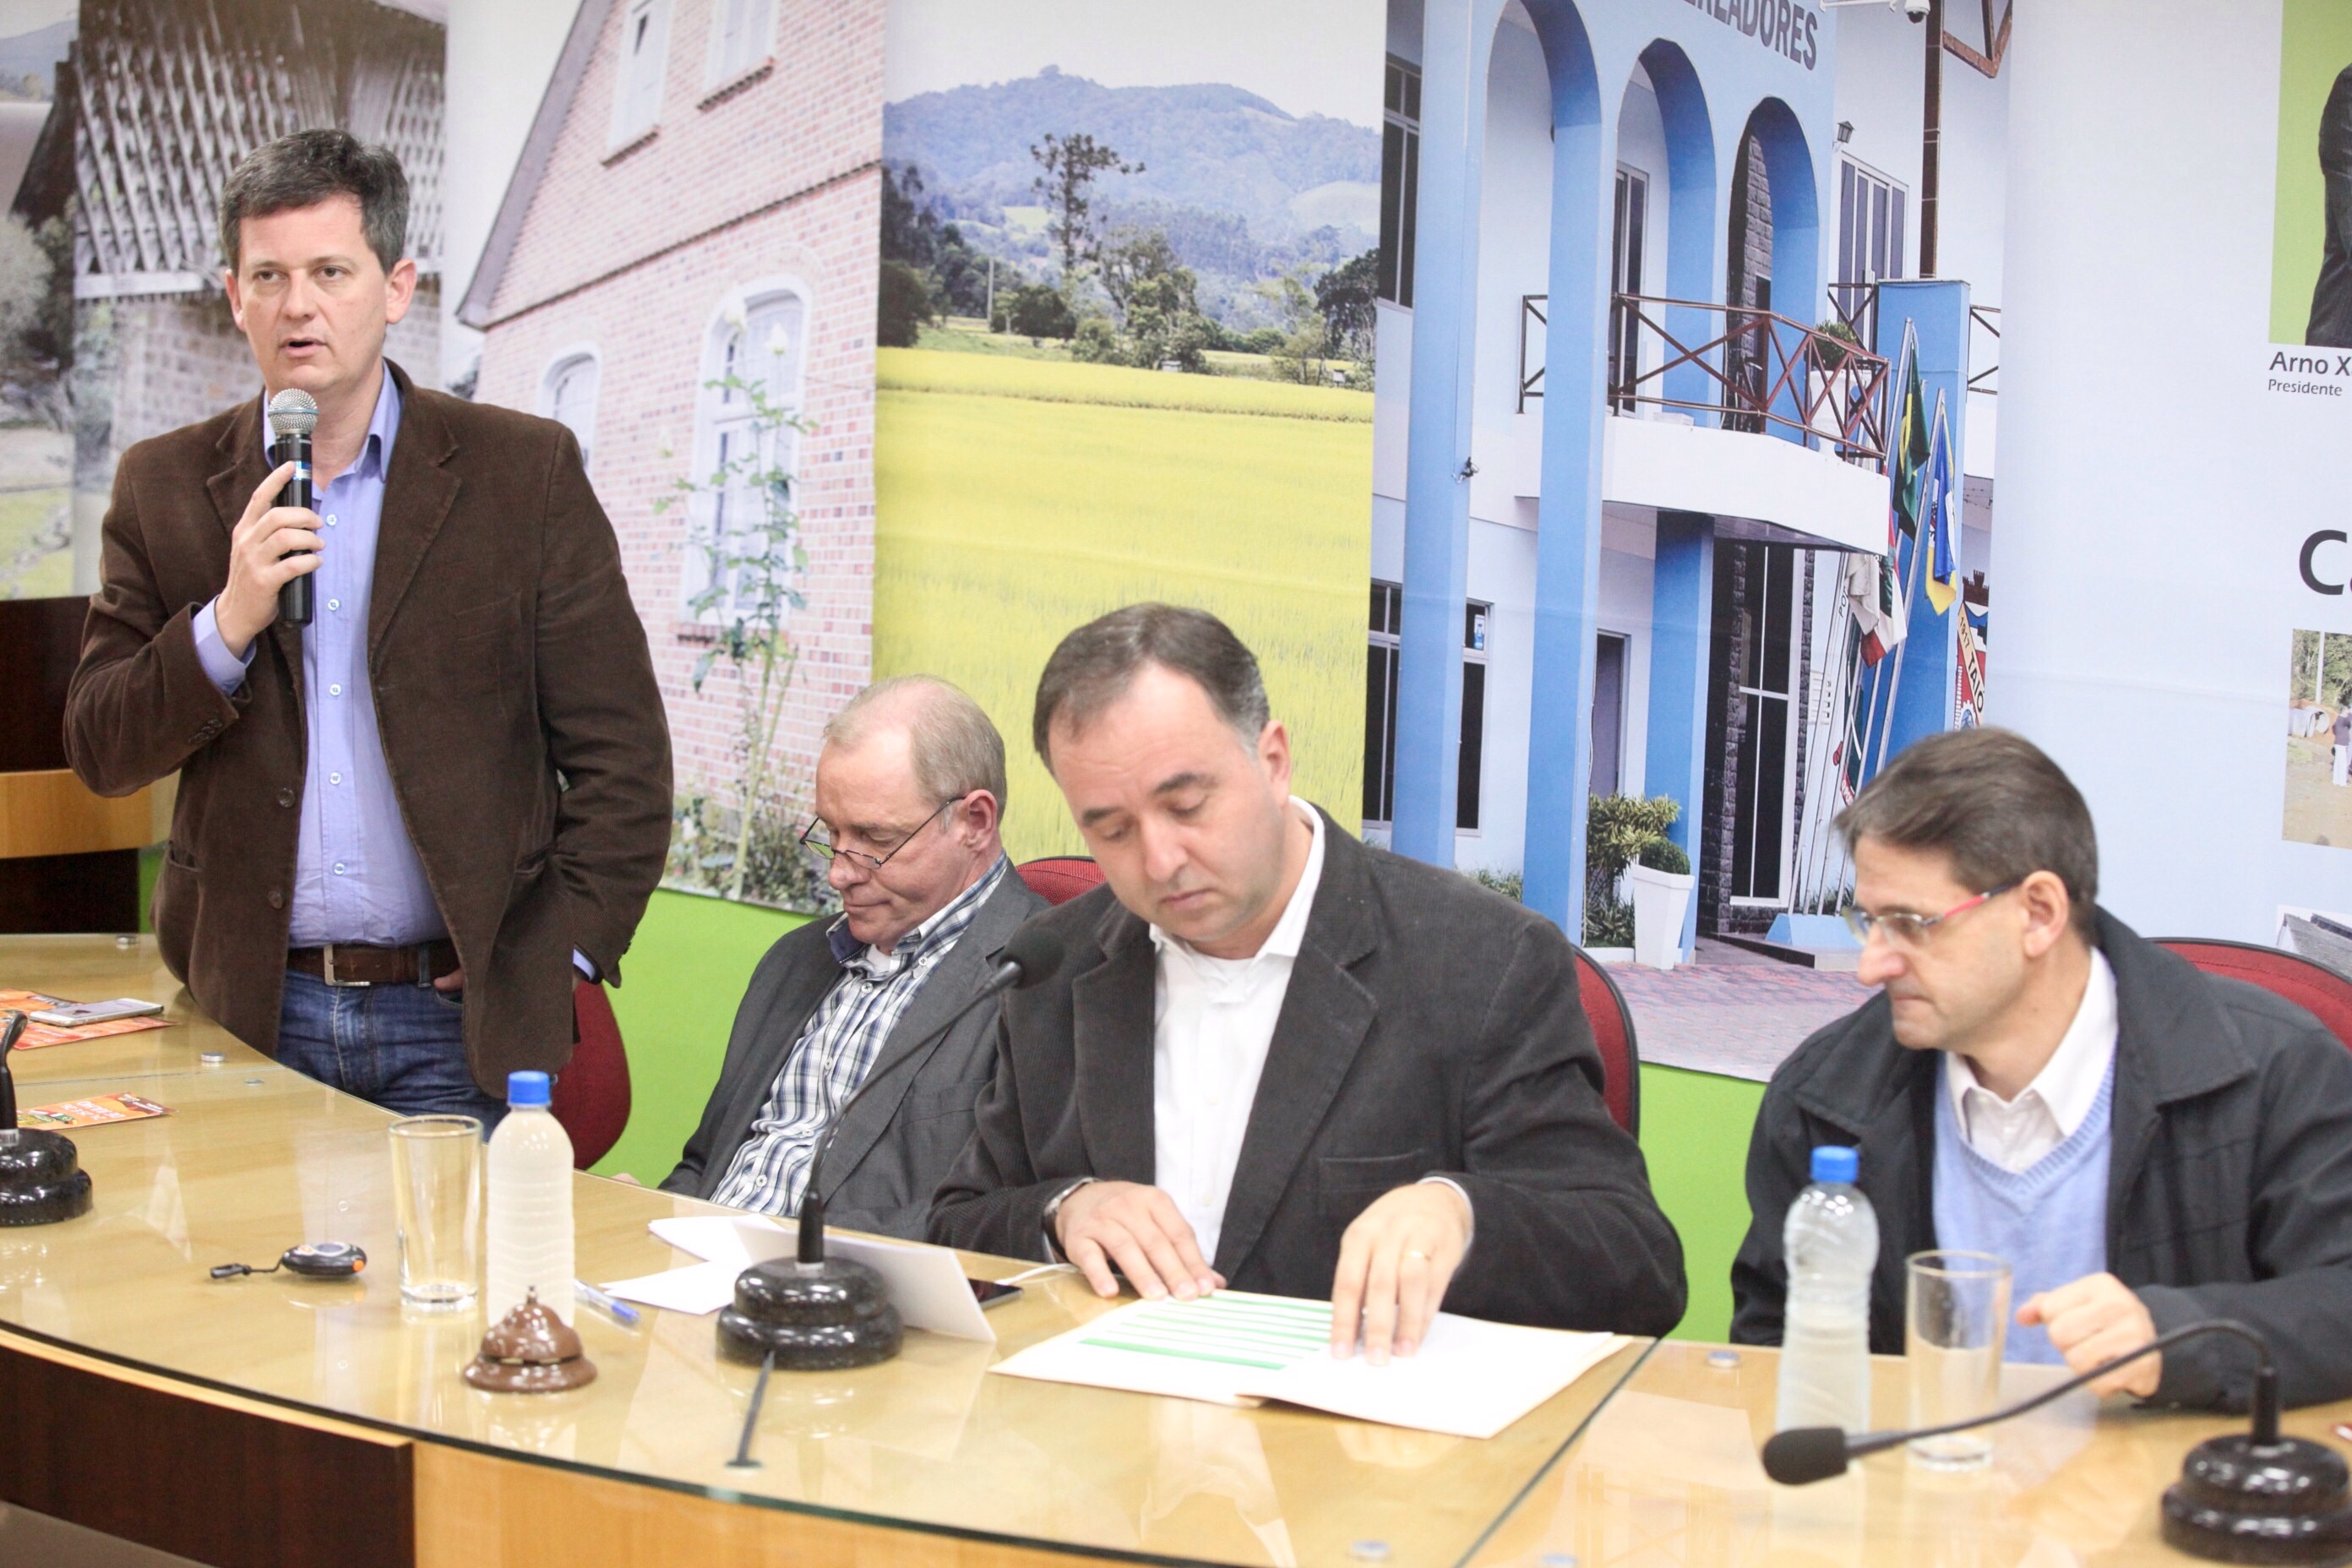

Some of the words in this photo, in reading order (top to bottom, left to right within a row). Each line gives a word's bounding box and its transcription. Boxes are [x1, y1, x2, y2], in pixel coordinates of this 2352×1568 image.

[1684, 0, 1818, 70] ADORES
[2269, 351, 2328, 374] Arno
[2334, 356, 2352, 377] X
[2268, 379, 2343, 396] Presidente
[2299, 529, 2352, 596] C
